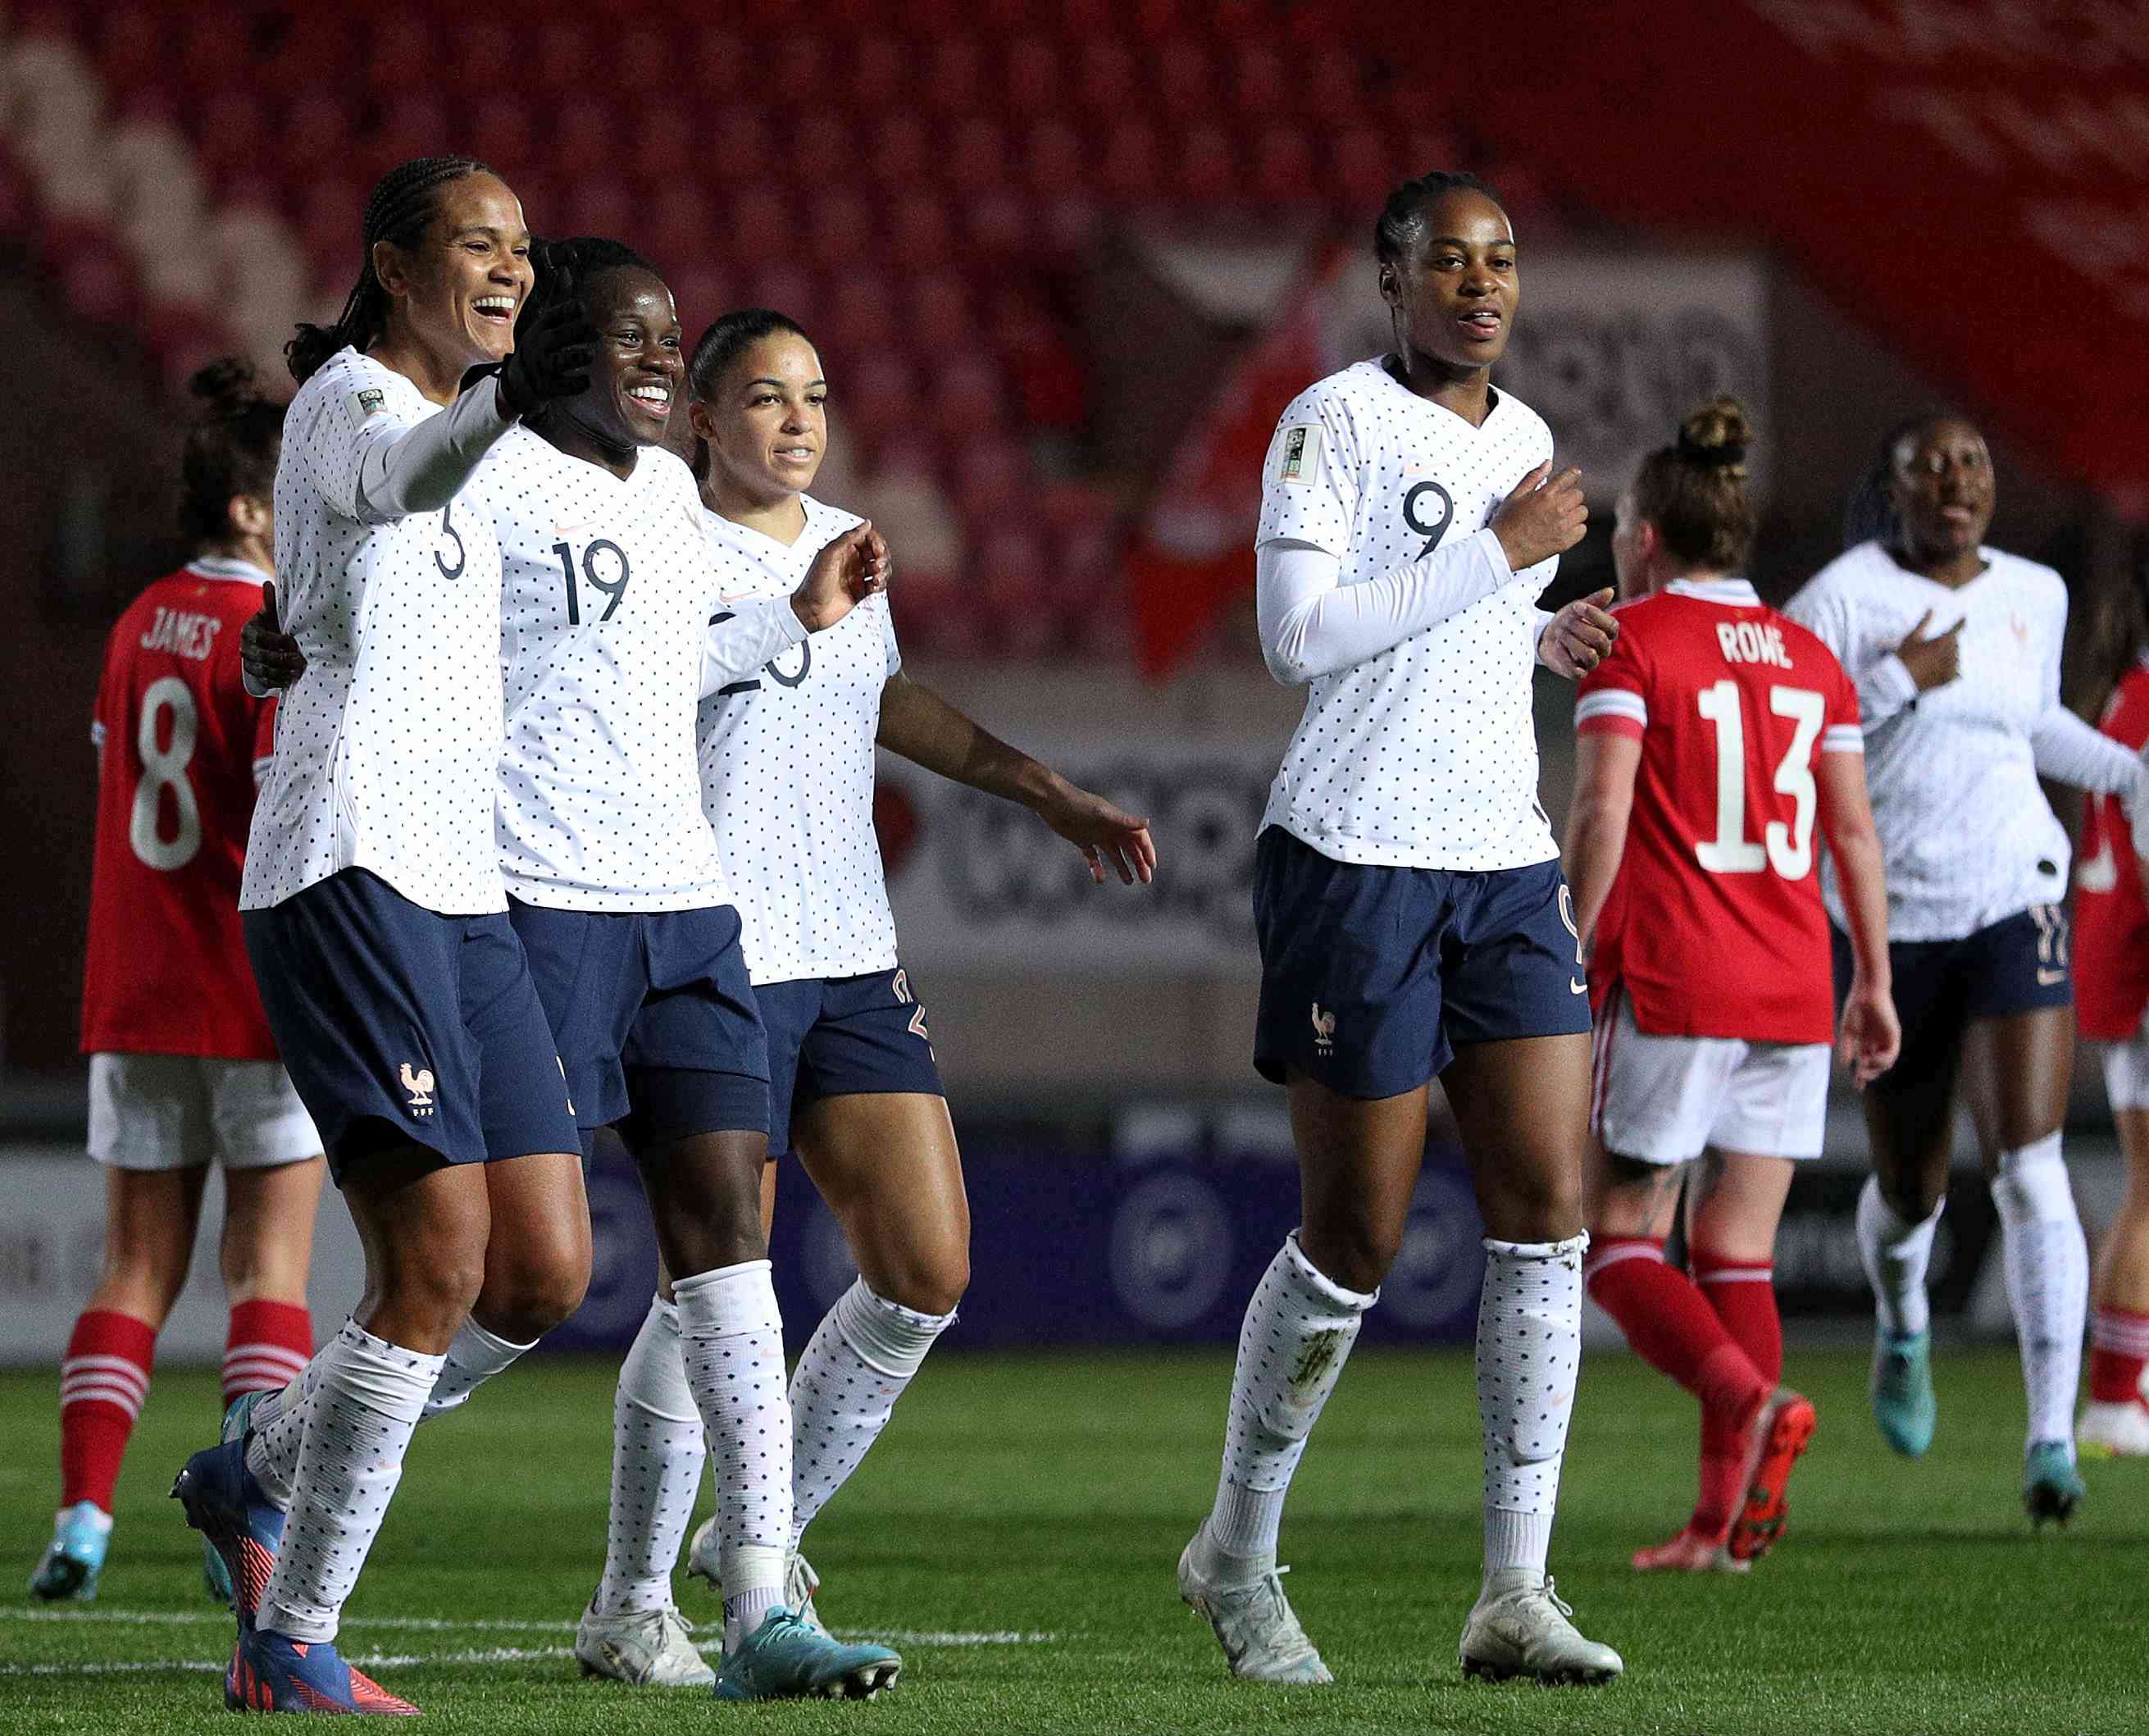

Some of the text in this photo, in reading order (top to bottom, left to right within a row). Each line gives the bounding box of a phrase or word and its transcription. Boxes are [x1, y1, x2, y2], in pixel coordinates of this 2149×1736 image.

[1403, 481, 1454, 563] 9
[552, 538, 630, 626] 19
[140, 606, 222, 661] JAMES
[1715, 621, 1794, 670] ROWE
[130, 677, 201, 871] 8
[1695, 680, 1826, 881] 13
